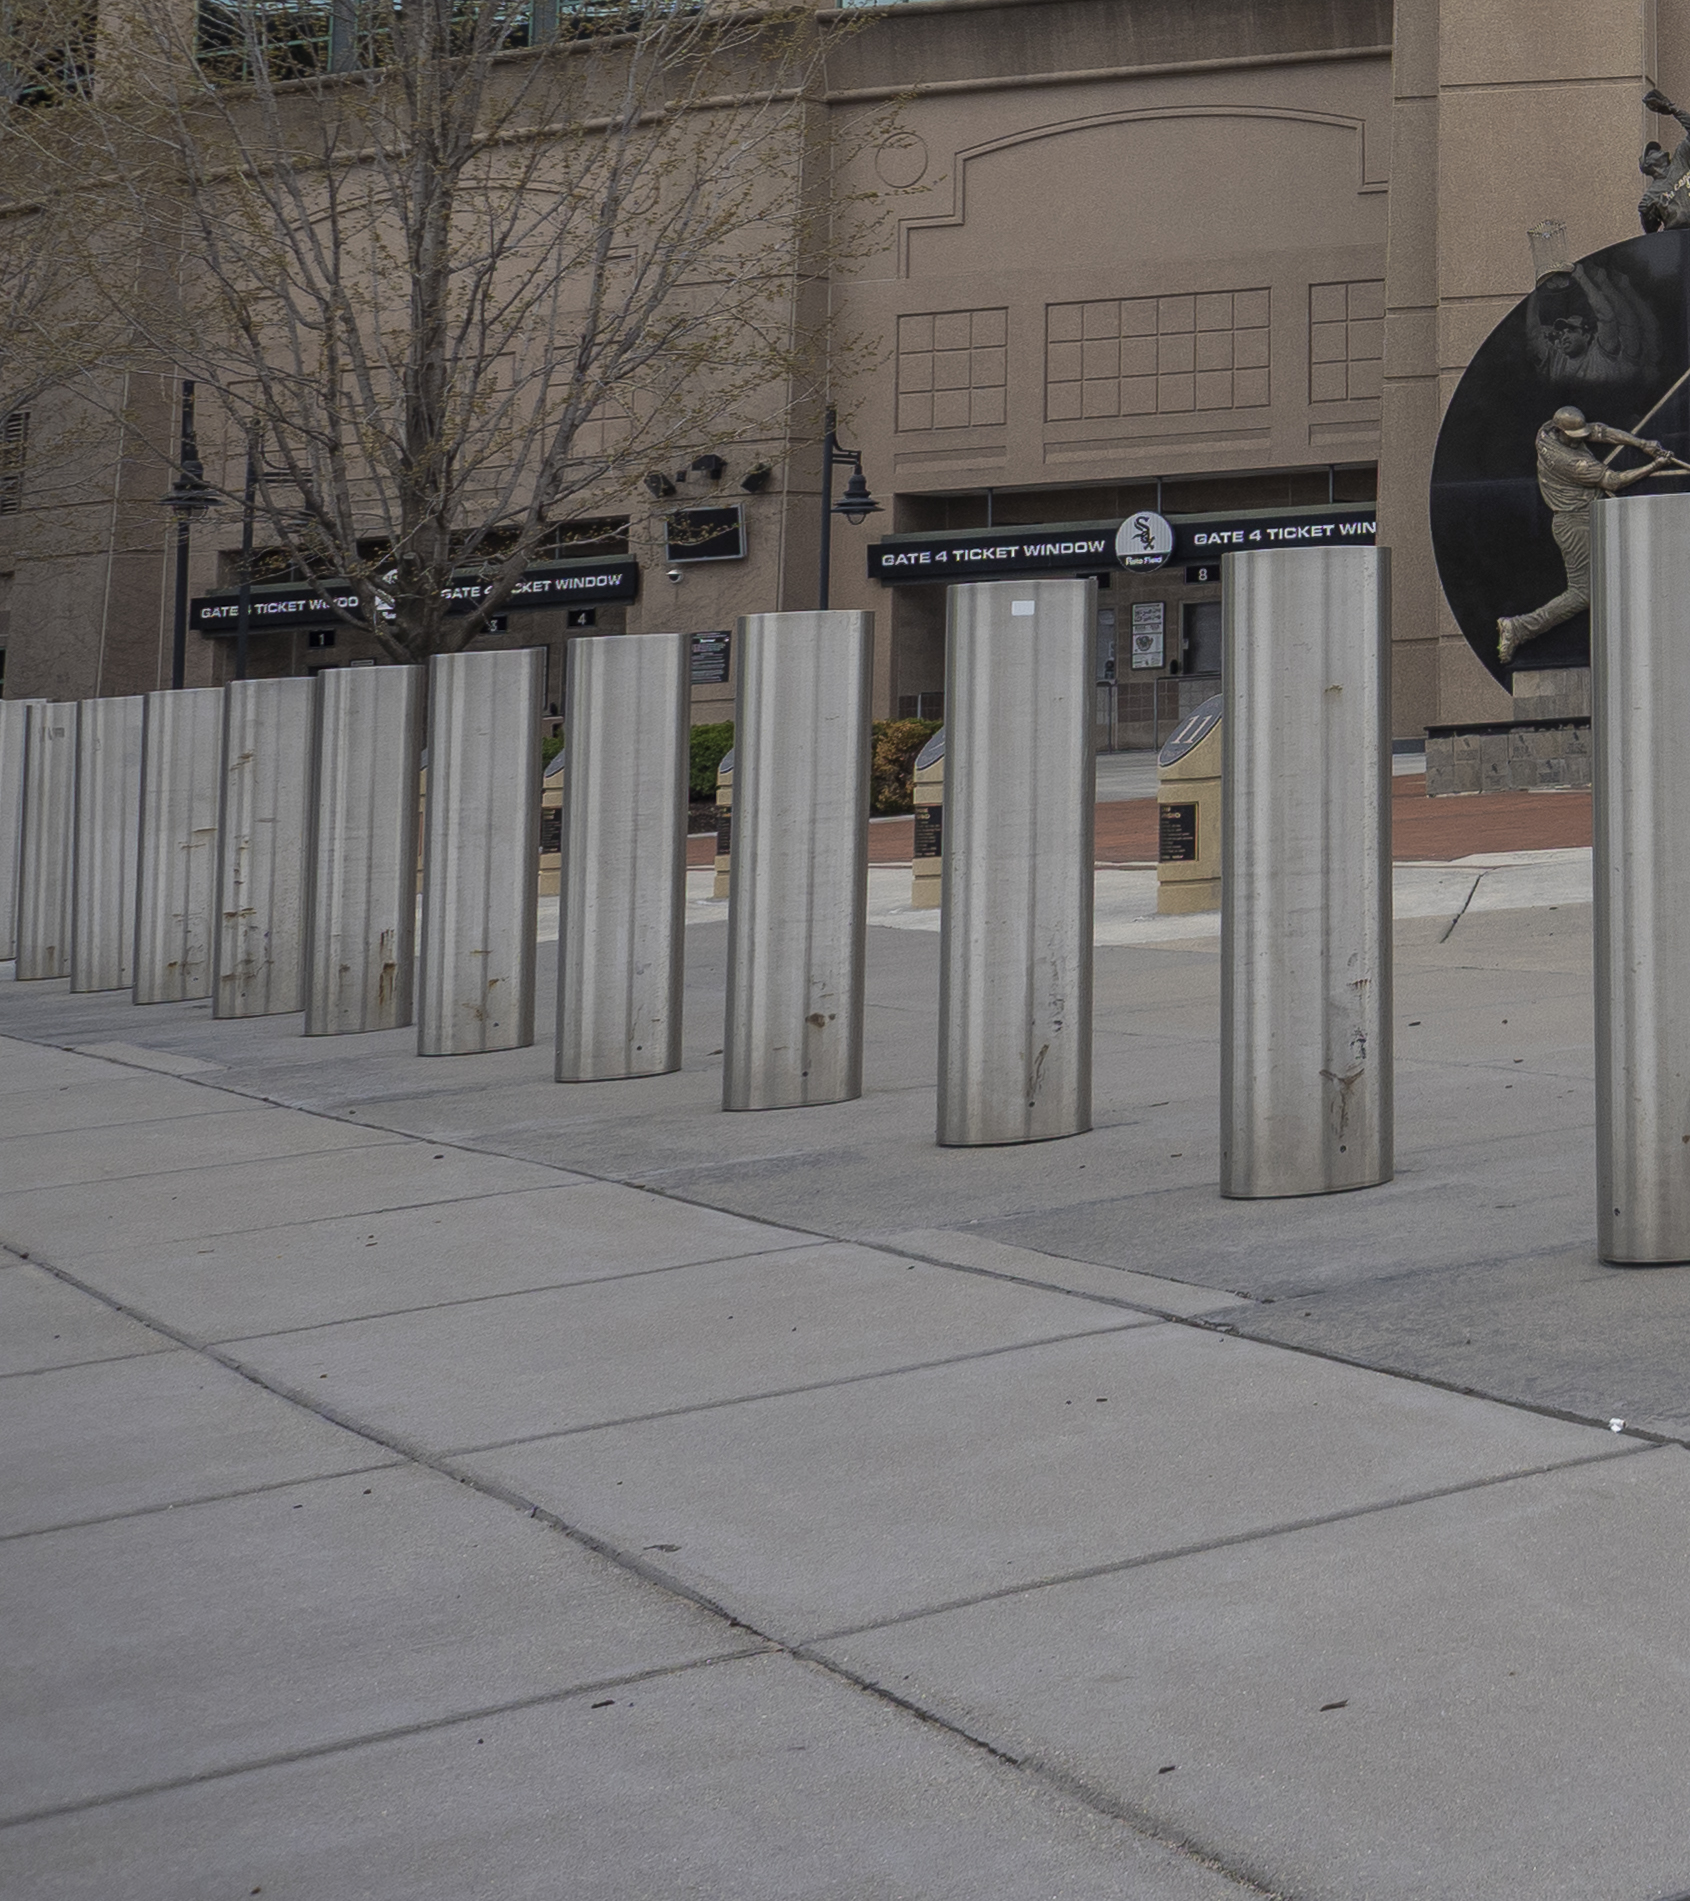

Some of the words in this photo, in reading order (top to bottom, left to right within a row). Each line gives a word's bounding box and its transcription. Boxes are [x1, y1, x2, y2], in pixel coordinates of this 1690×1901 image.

[1194, 530, 1244, 545] GATE
[1248, 529, 1262, 542] 4
[1266, 524, 1335, 541] TICKET
[1339, 521, 1377, 536] WIN
[881, 551, 931, 566] GATE
[934, 550, 948, 562] 4
[952, 546, 1019, 561] TICKET
[1023, 540, 1106, 557] WINDOW
[555, 573, 623, 590] WINDOW
[1198, 567, 1208, 581] 8
[201, 604, 240, 619] GATE
[254, 599, 306, 615] TICKET
[577, 612, 587, 625] 4
[318, 633, 326, 646] 1
[1170, 714, 1213, 744] 11
